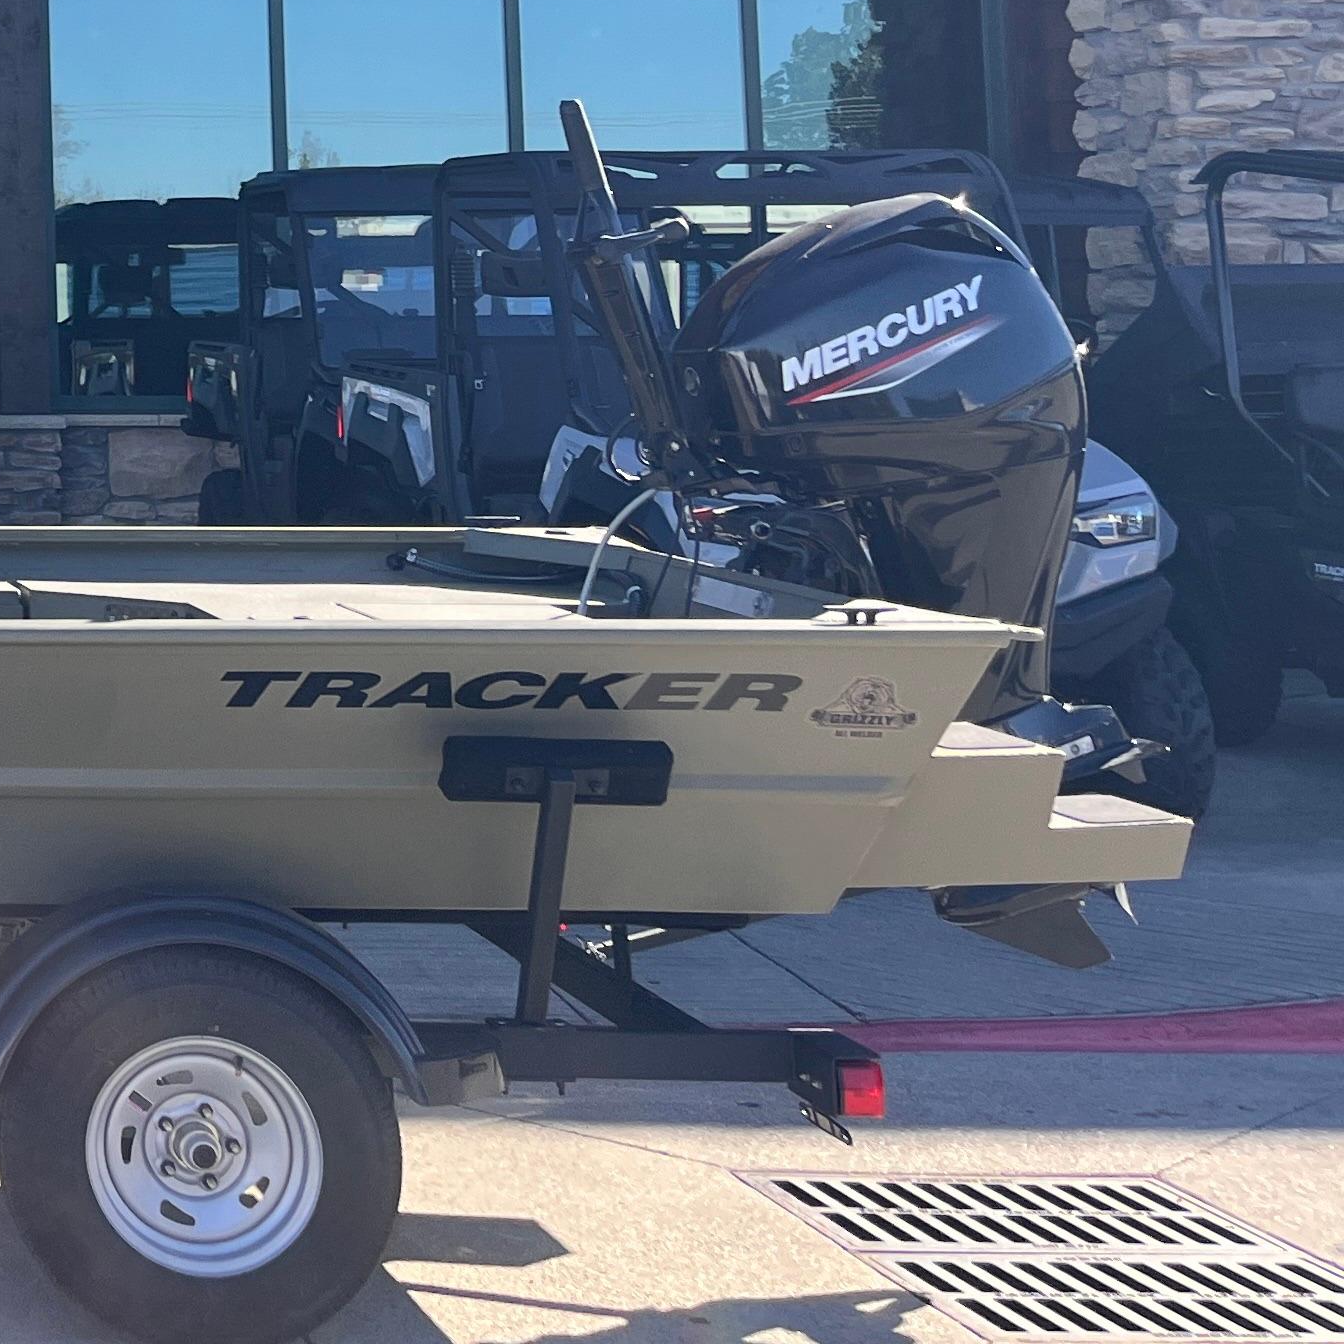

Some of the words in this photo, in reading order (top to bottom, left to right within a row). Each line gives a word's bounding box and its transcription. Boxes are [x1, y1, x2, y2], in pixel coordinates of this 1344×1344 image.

[781, 274, 983, 393] MERCURY
[220, 670, 804, 713] TRACKER
[830, 714, 893, 725] GRIZZLY
